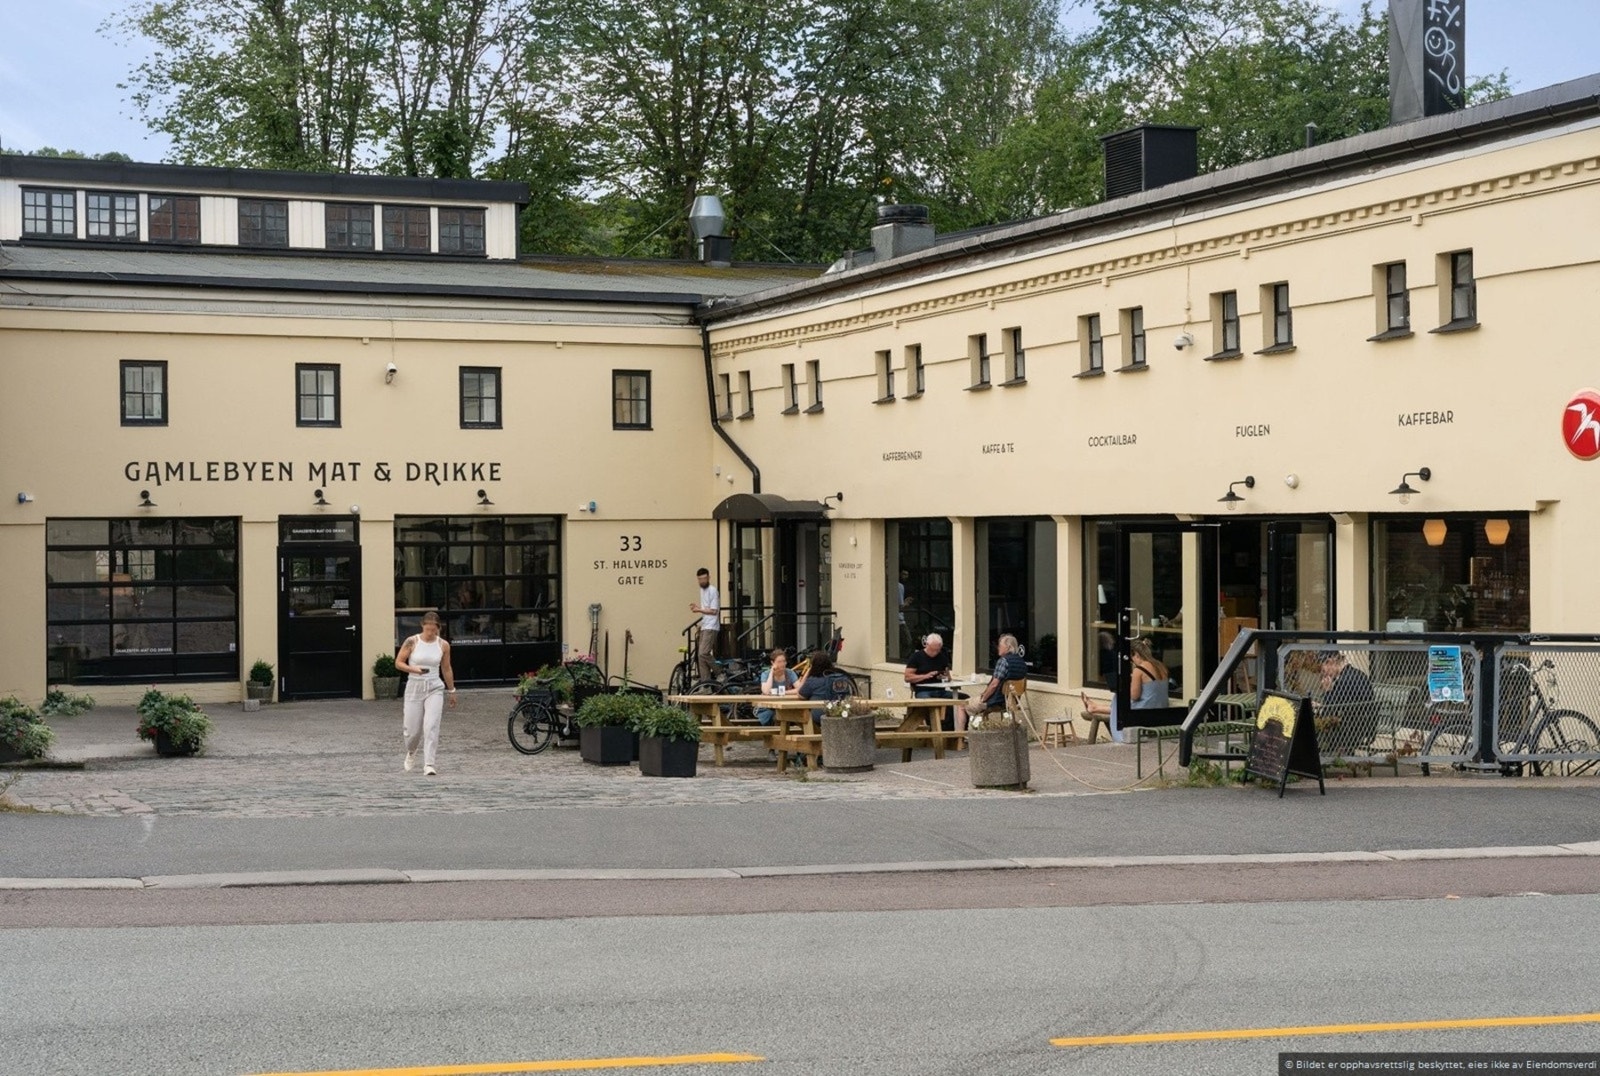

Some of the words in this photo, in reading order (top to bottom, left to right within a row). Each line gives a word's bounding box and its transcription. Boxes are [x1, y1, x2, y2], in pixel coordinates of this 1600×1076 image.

[1398, 410, 1454, 426] KAFFEBAR
[1236, 424, 1270, 437] FUGLEN
[1088, 434, 1137, 447] COCKTAILBAR
[982, 444, 1001, 454] KAFFE
[1007, 442, 1015, 453] TE
[882, 450, 923, 462] KAFFEBRENNERI
[125, 462, 292, 486] GAMLEBYEN
[309, 462, 361, 487] MAT
[374, 462, 392, 483] &
[406, 462, 502, 487] DRIKKE
[620, 536, 642, 551] 33
[593, 560, 608, 570] ST.
[613, 559, 668, 569] HALVARDS
[618, 576, 644, 586] GATE
